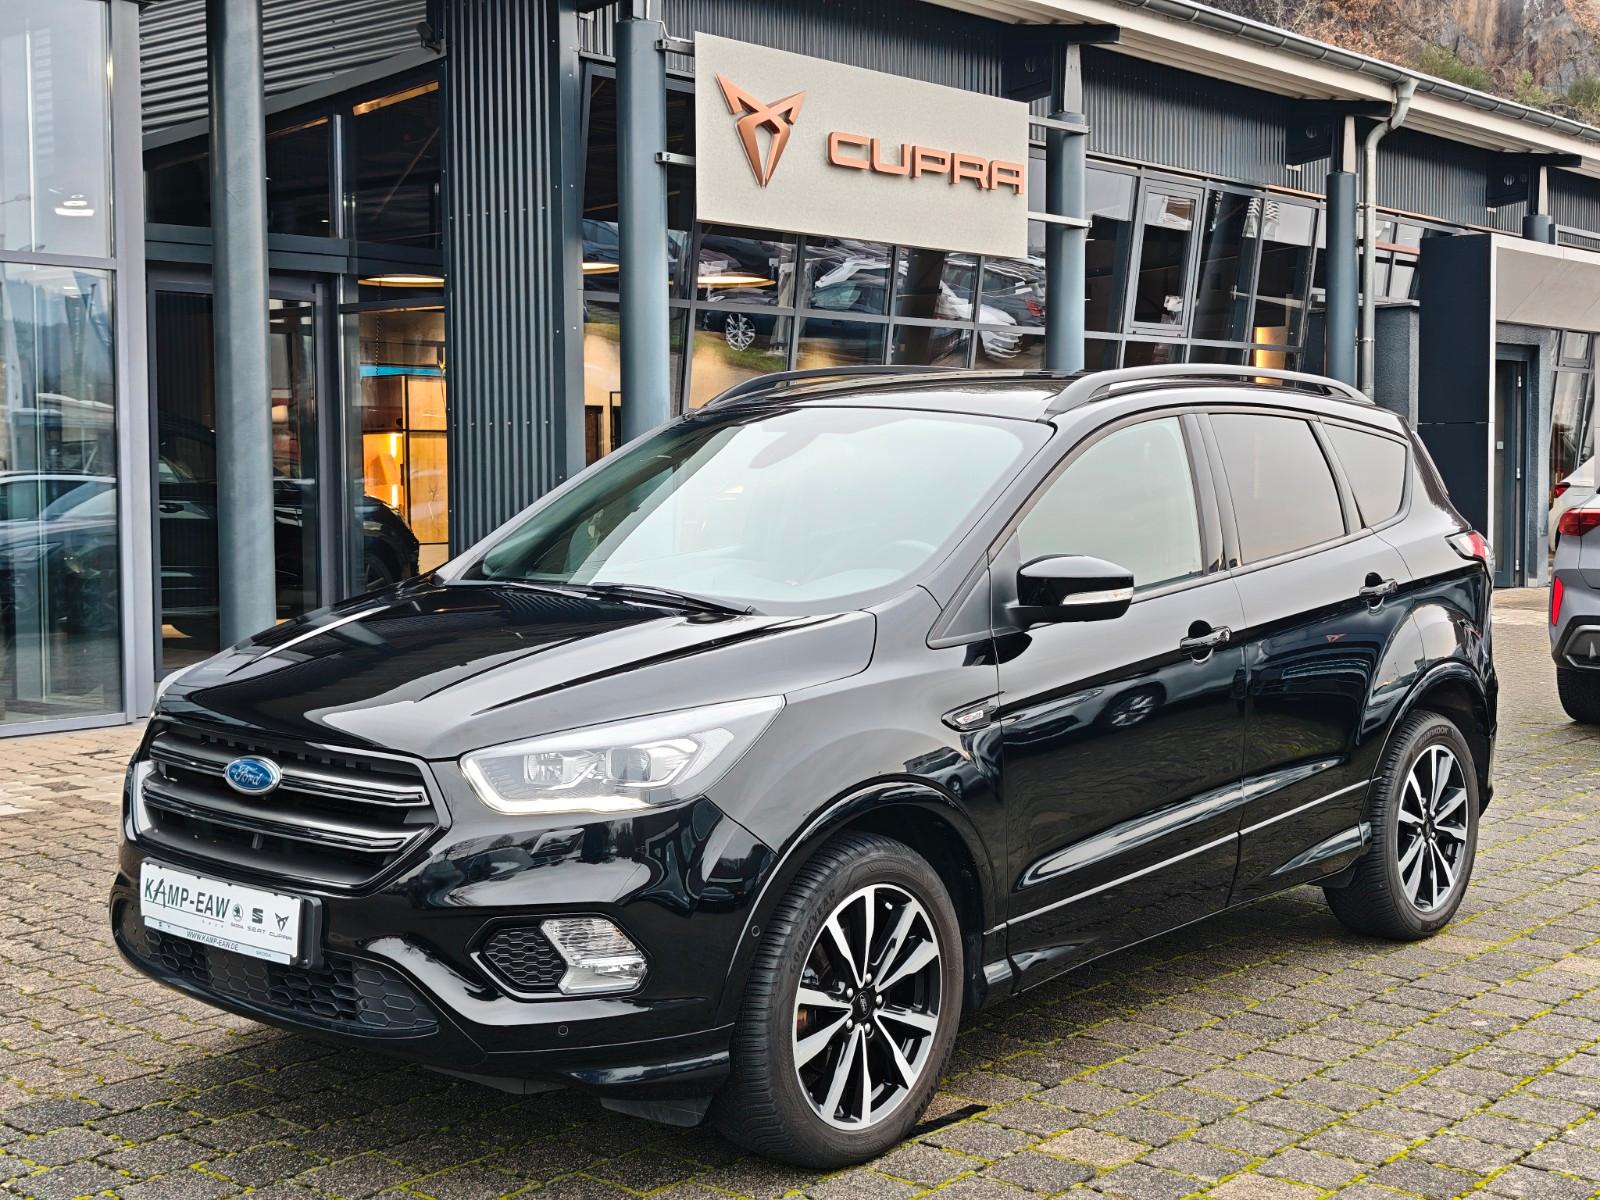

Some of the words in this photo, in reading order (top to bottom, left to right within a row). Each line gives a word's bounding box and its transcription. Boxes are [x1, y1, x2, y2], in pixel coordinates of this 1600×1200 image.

[827, 131, 1025, 195] CUPRA
[233, 764, 267, 786] Ford
[144, 877, 231, 919] KAMP-EAW
[247, 925, 266, 934] SEAT
[269, 931, 292, 941] CUPRA
